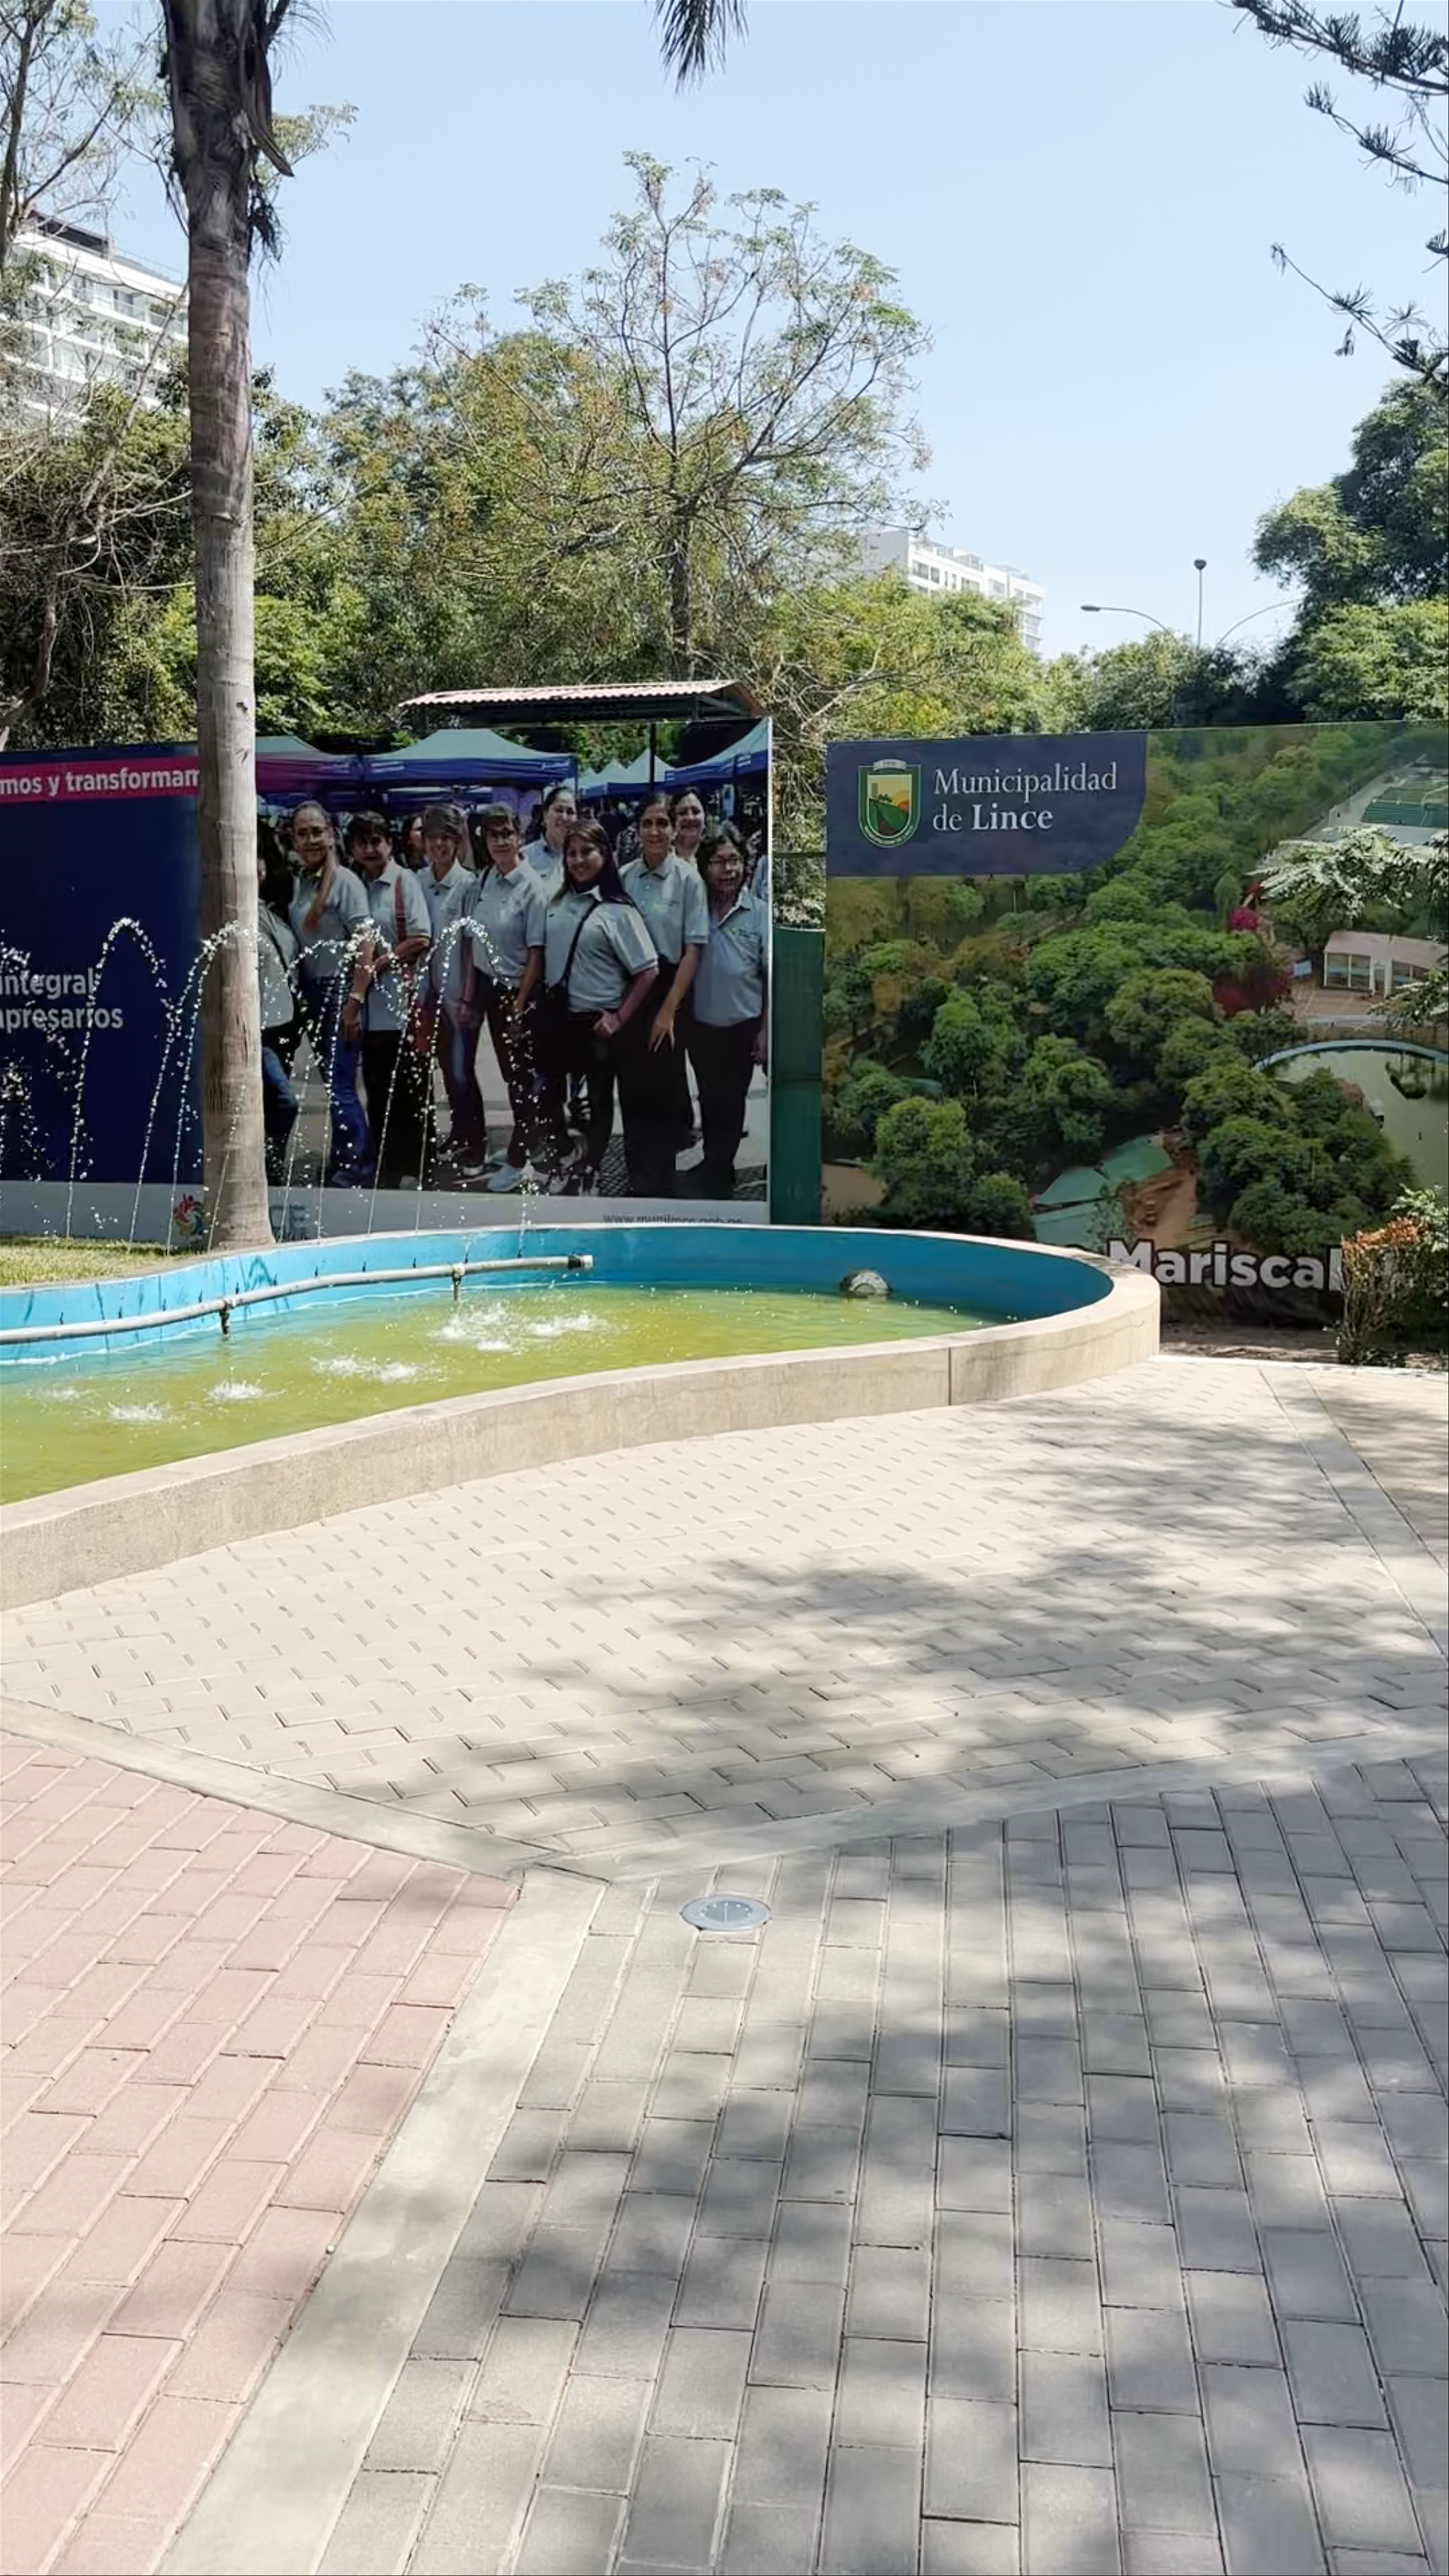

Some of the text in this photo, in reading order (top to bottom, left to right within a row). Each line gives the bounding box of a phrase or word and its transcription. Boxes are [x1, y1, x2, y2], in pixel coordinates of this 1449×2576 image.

[48, 775, 60, 797] y
[934, 761, 1117, 804] Municipalidad
[933, 802, 1054, 831] de Lince
[1108, 1239, 1342, 1292] Mariscal
